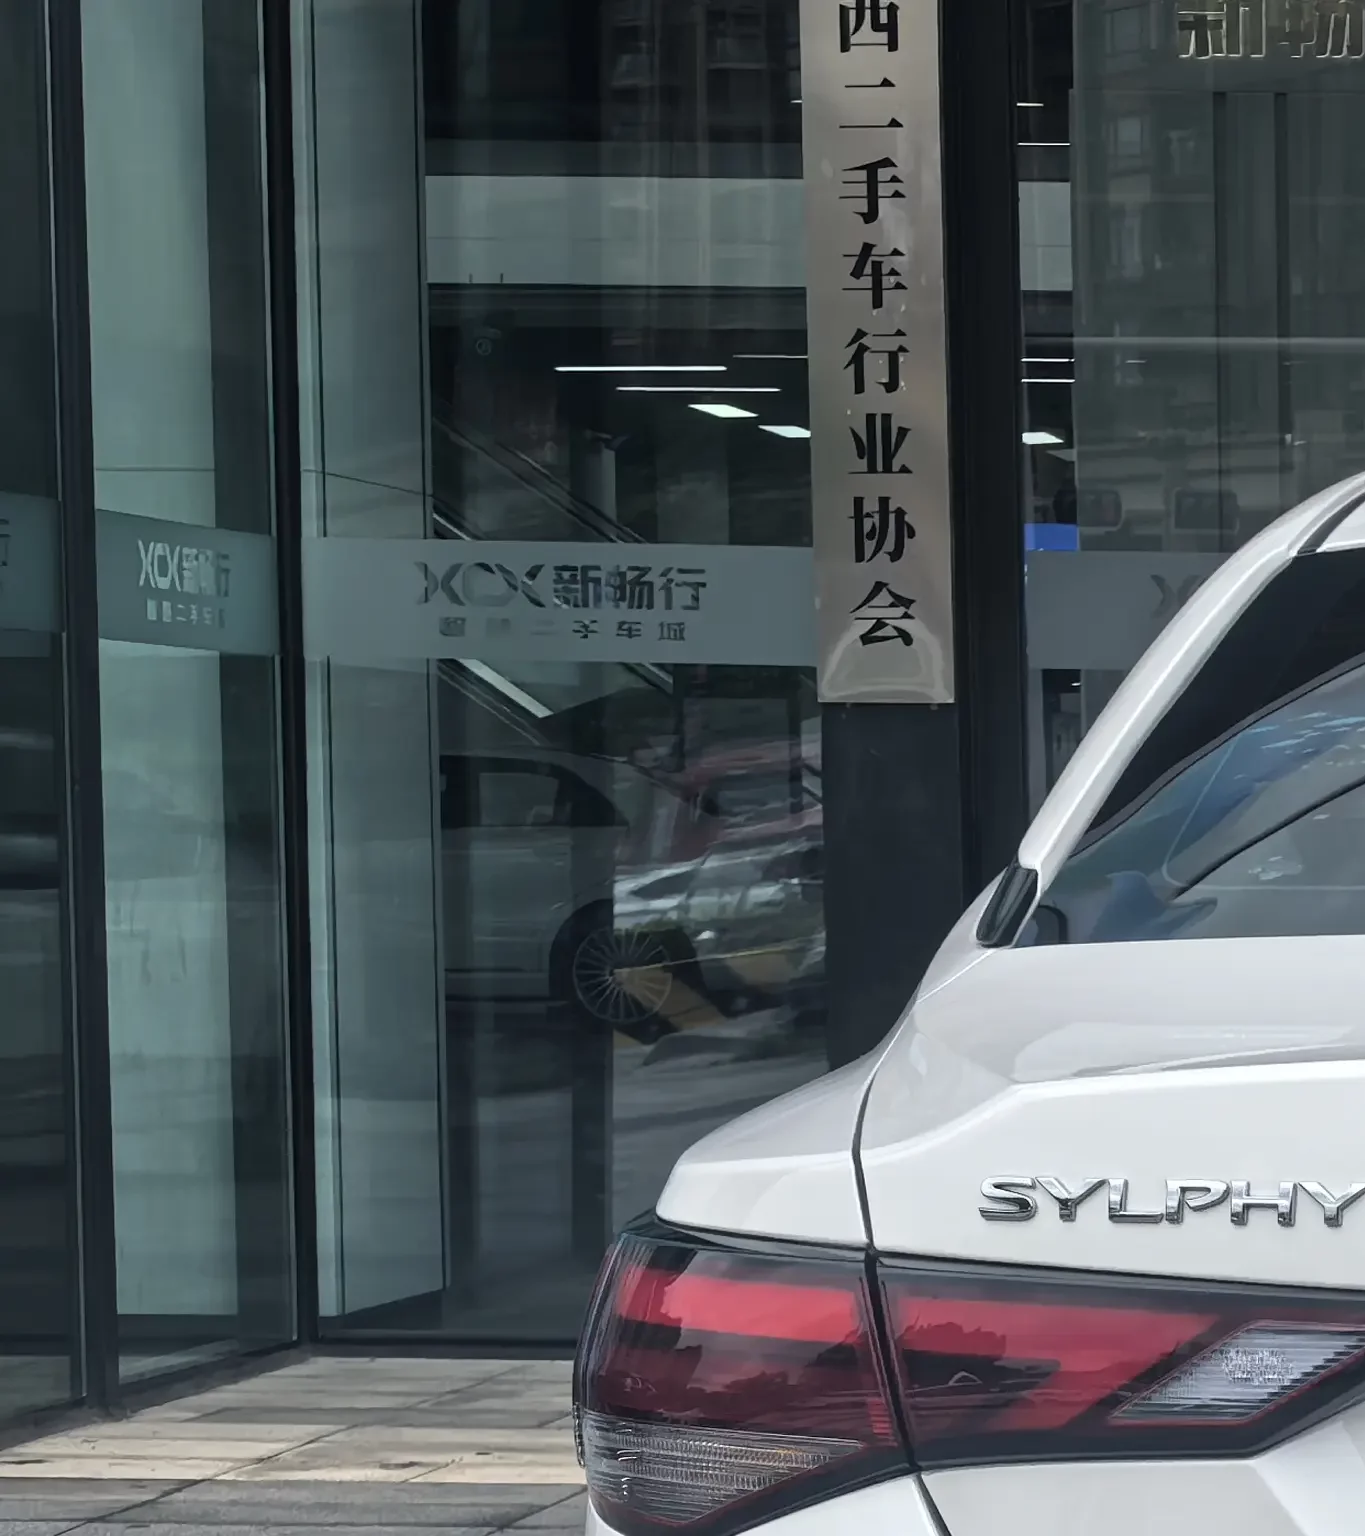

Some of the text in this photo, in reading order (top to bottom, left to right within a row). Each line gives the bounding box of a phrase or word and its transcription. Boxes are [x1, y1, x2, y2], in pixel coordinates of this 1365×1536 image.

[838, 0, 917, 648] 西二手车行业协会
[552, 564, 707, 611] 新畅行
